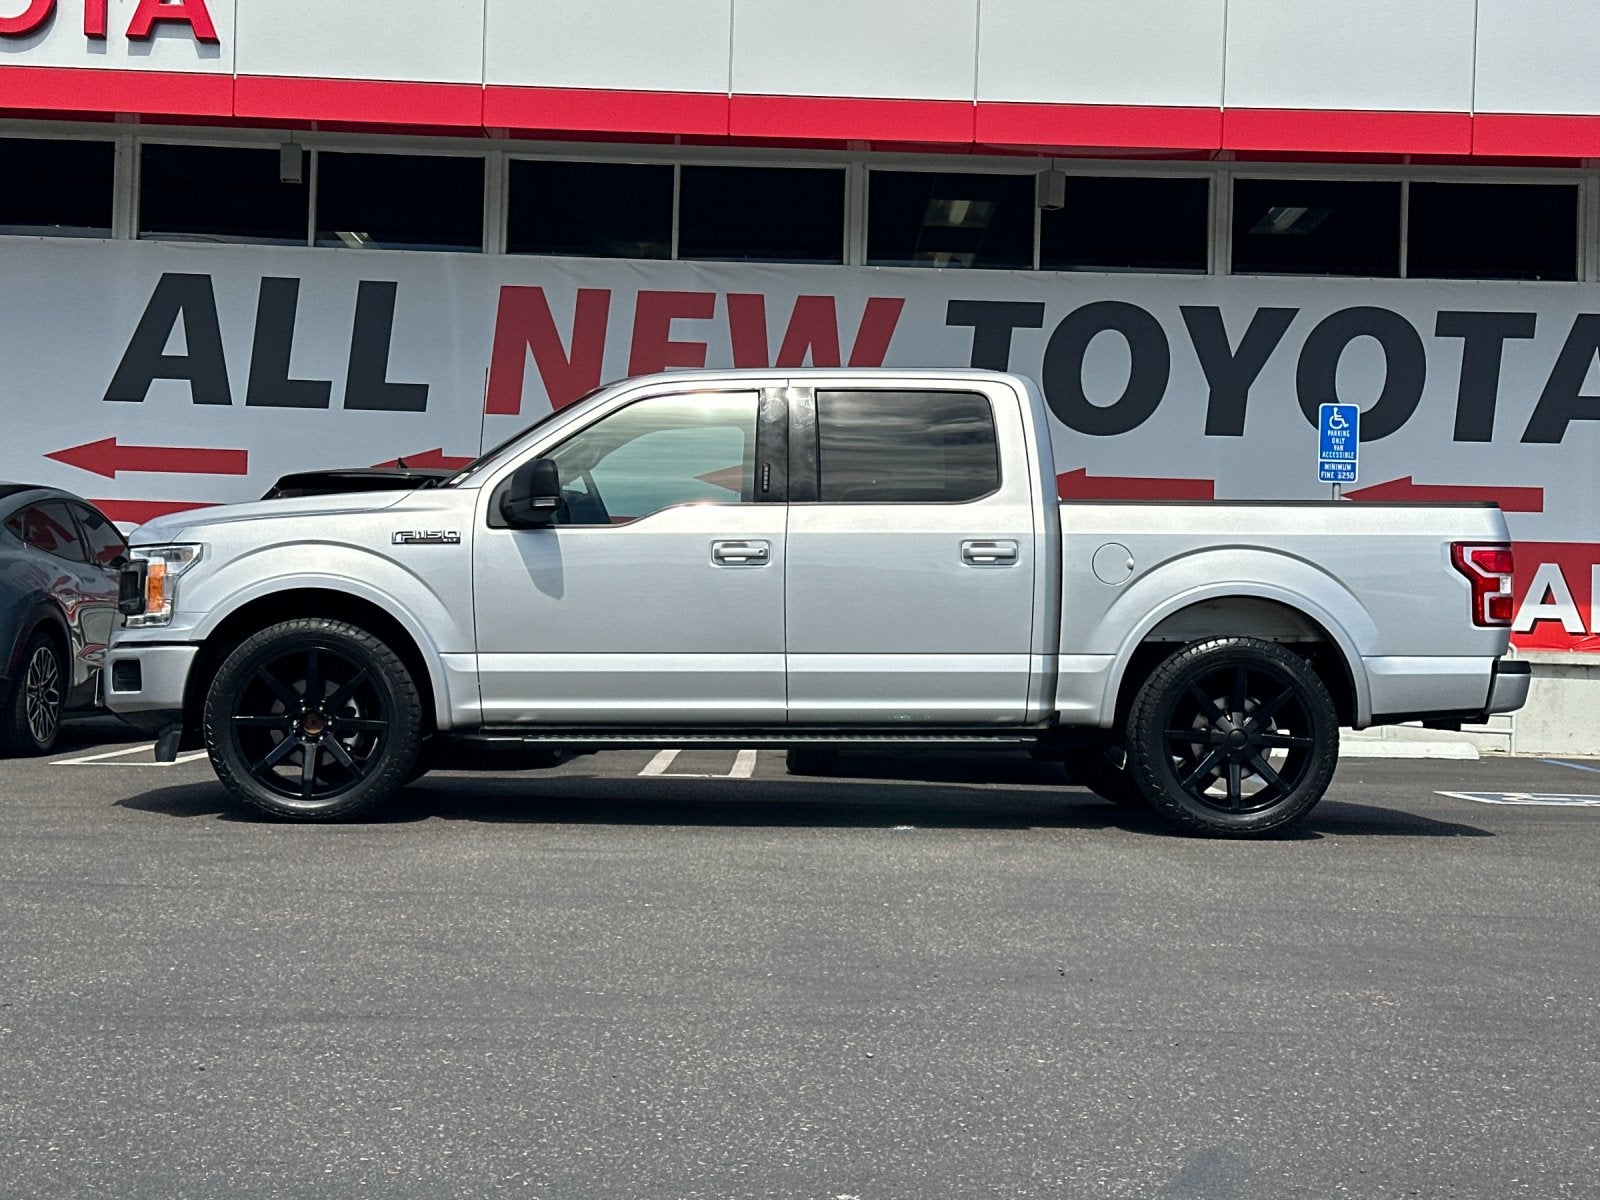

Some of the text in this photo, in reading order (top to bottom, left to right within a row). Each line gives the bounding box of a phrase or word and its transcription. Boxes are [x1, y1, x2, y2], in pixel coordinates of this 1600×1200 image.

[103, 272, 429, 413] ALL
[485, 285, 905, 415] NEW
[1322, 451, 1355, 459] ACCESSIBLE
[1324, 463, 1352, 471] MINIMUM
[1337, 471, 1354, 479] $250
